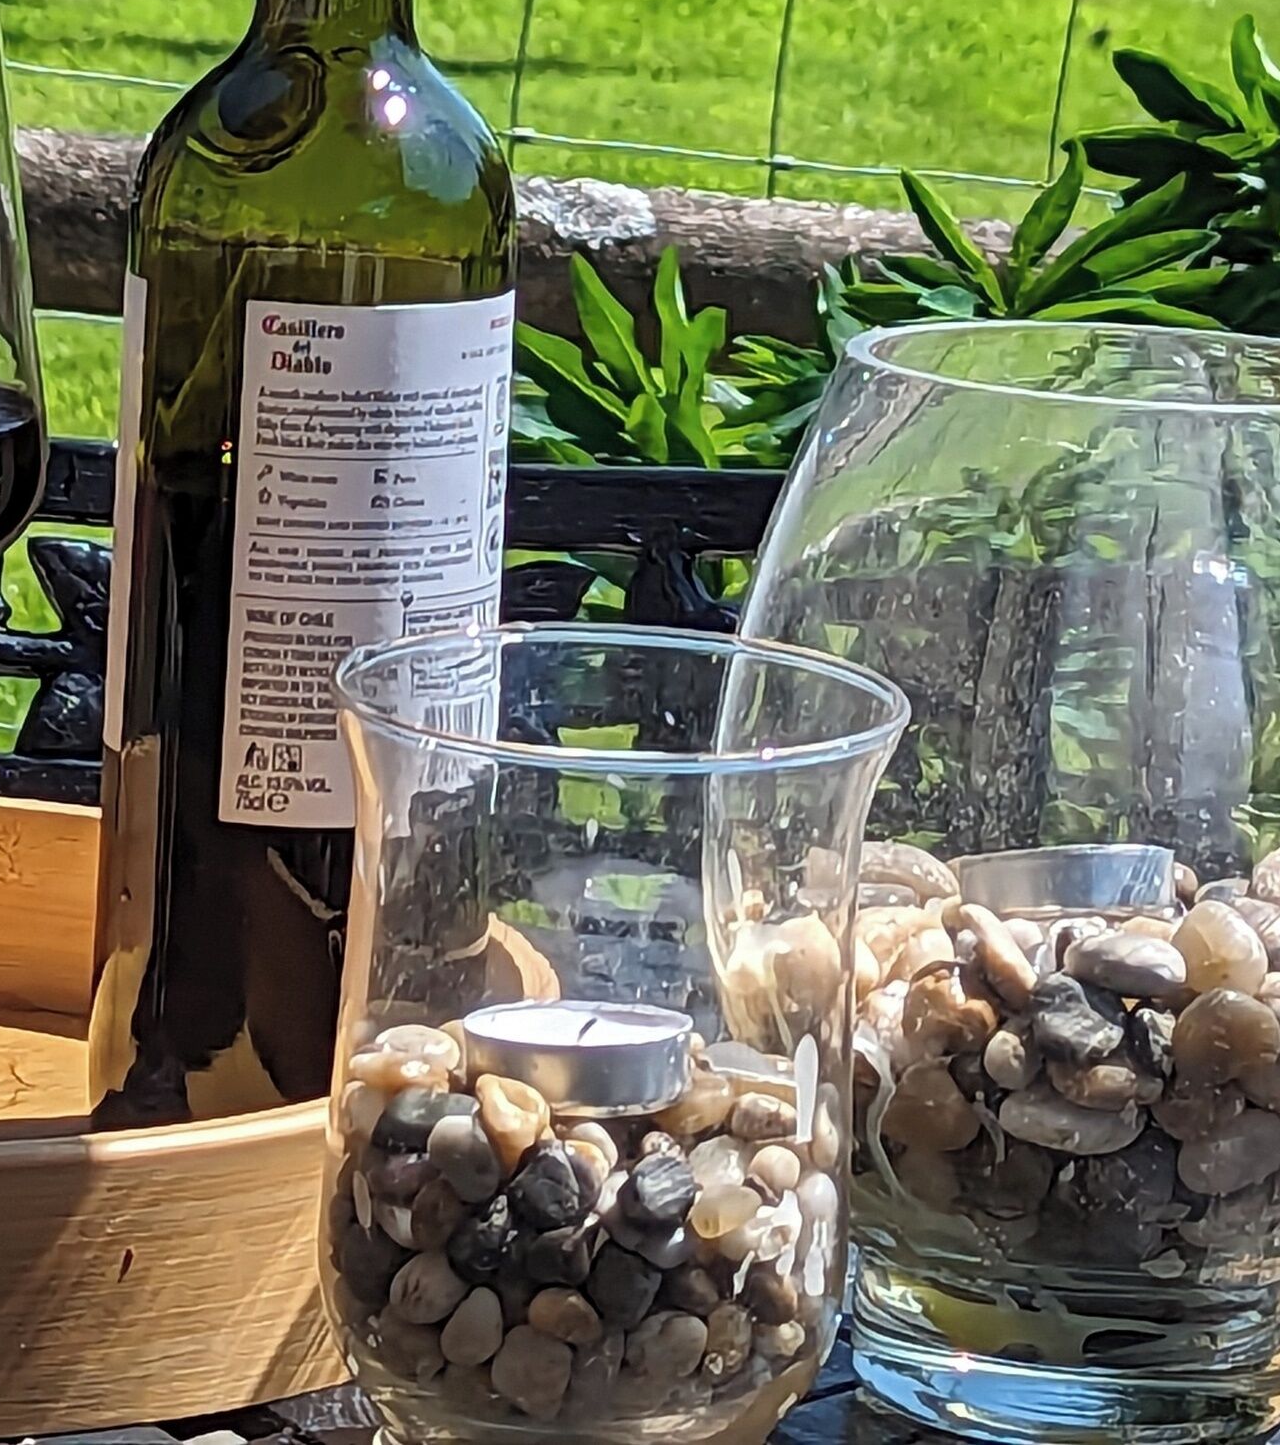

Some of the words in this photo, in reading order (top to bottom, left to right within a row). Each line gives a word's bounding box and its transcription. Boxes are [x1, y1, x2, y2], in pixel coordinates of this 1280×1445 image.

[262, 315, 345, 339] Casillero
[293, 340, 311, 354] del
[271, 351, 332, 374] Diablo
